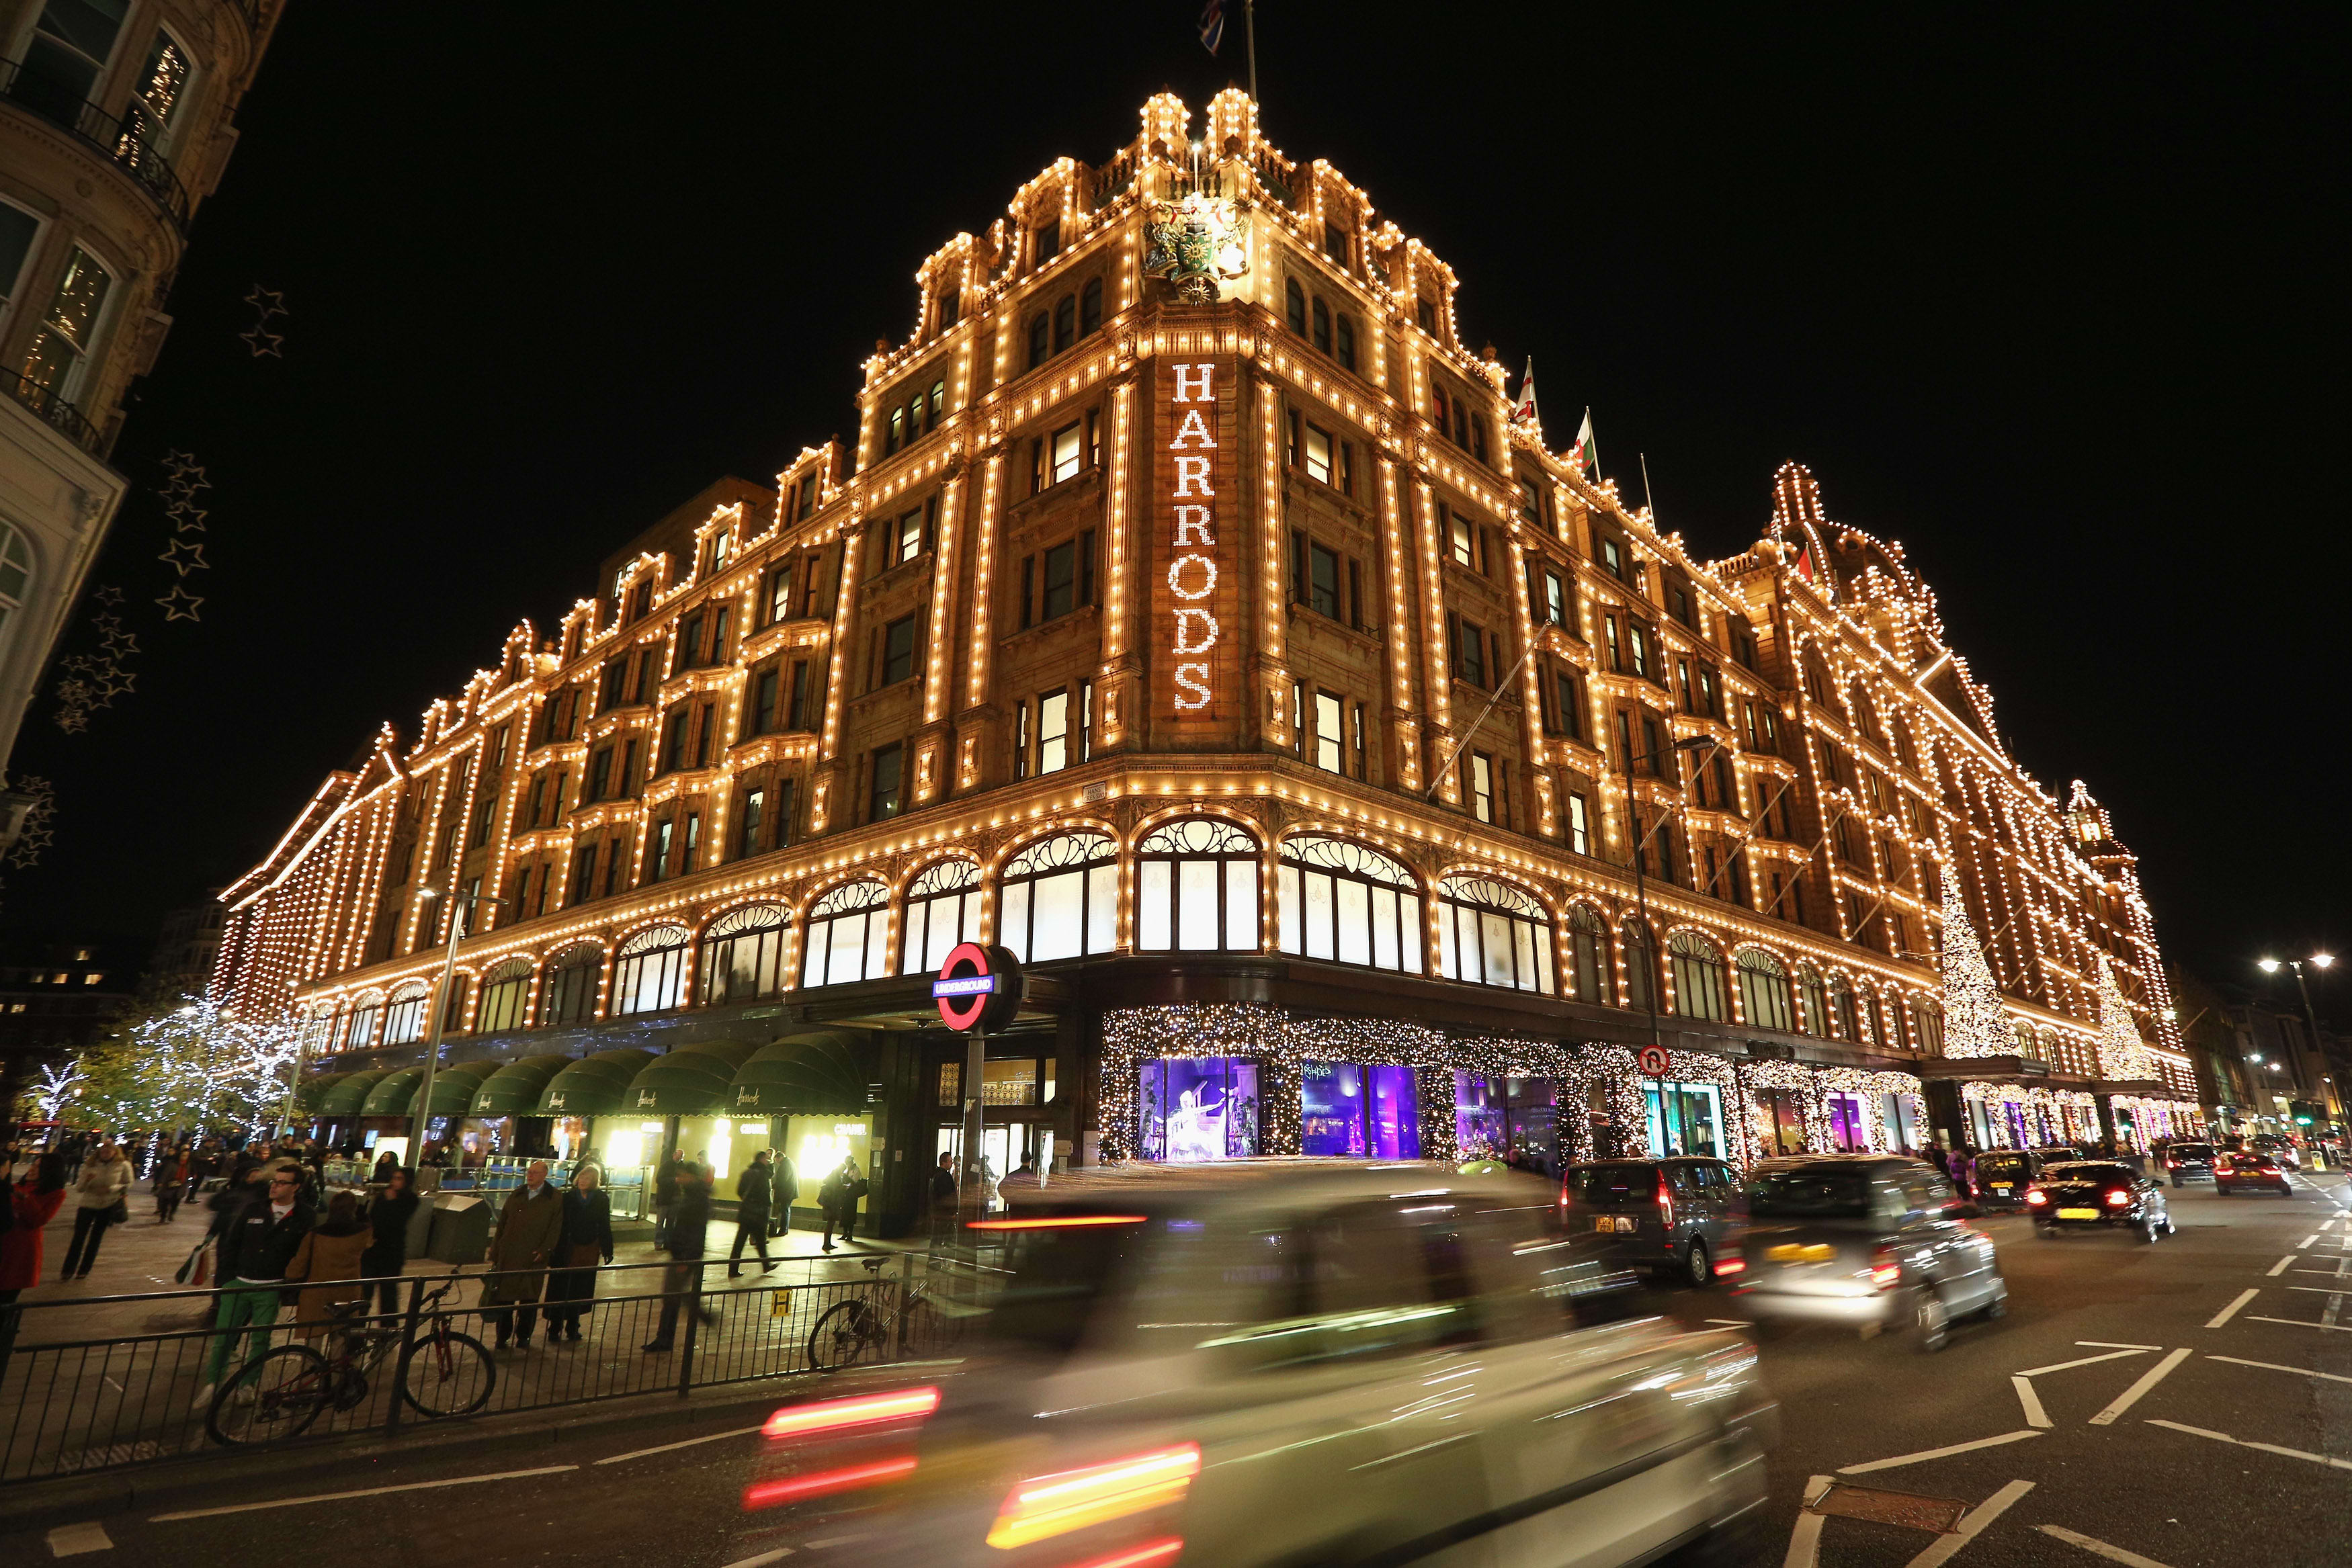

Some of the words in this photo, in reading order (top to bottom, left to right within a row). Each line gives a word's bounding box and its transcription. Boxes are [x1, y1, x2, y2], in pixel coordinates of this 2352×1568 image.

[1168, 363, 1218, 709] HARRODS
[935, 979, 991, 994] UNDERGROUND
[737, 1086, 759, 1106] Harrods
[773, 1292, 790, 1314] H
